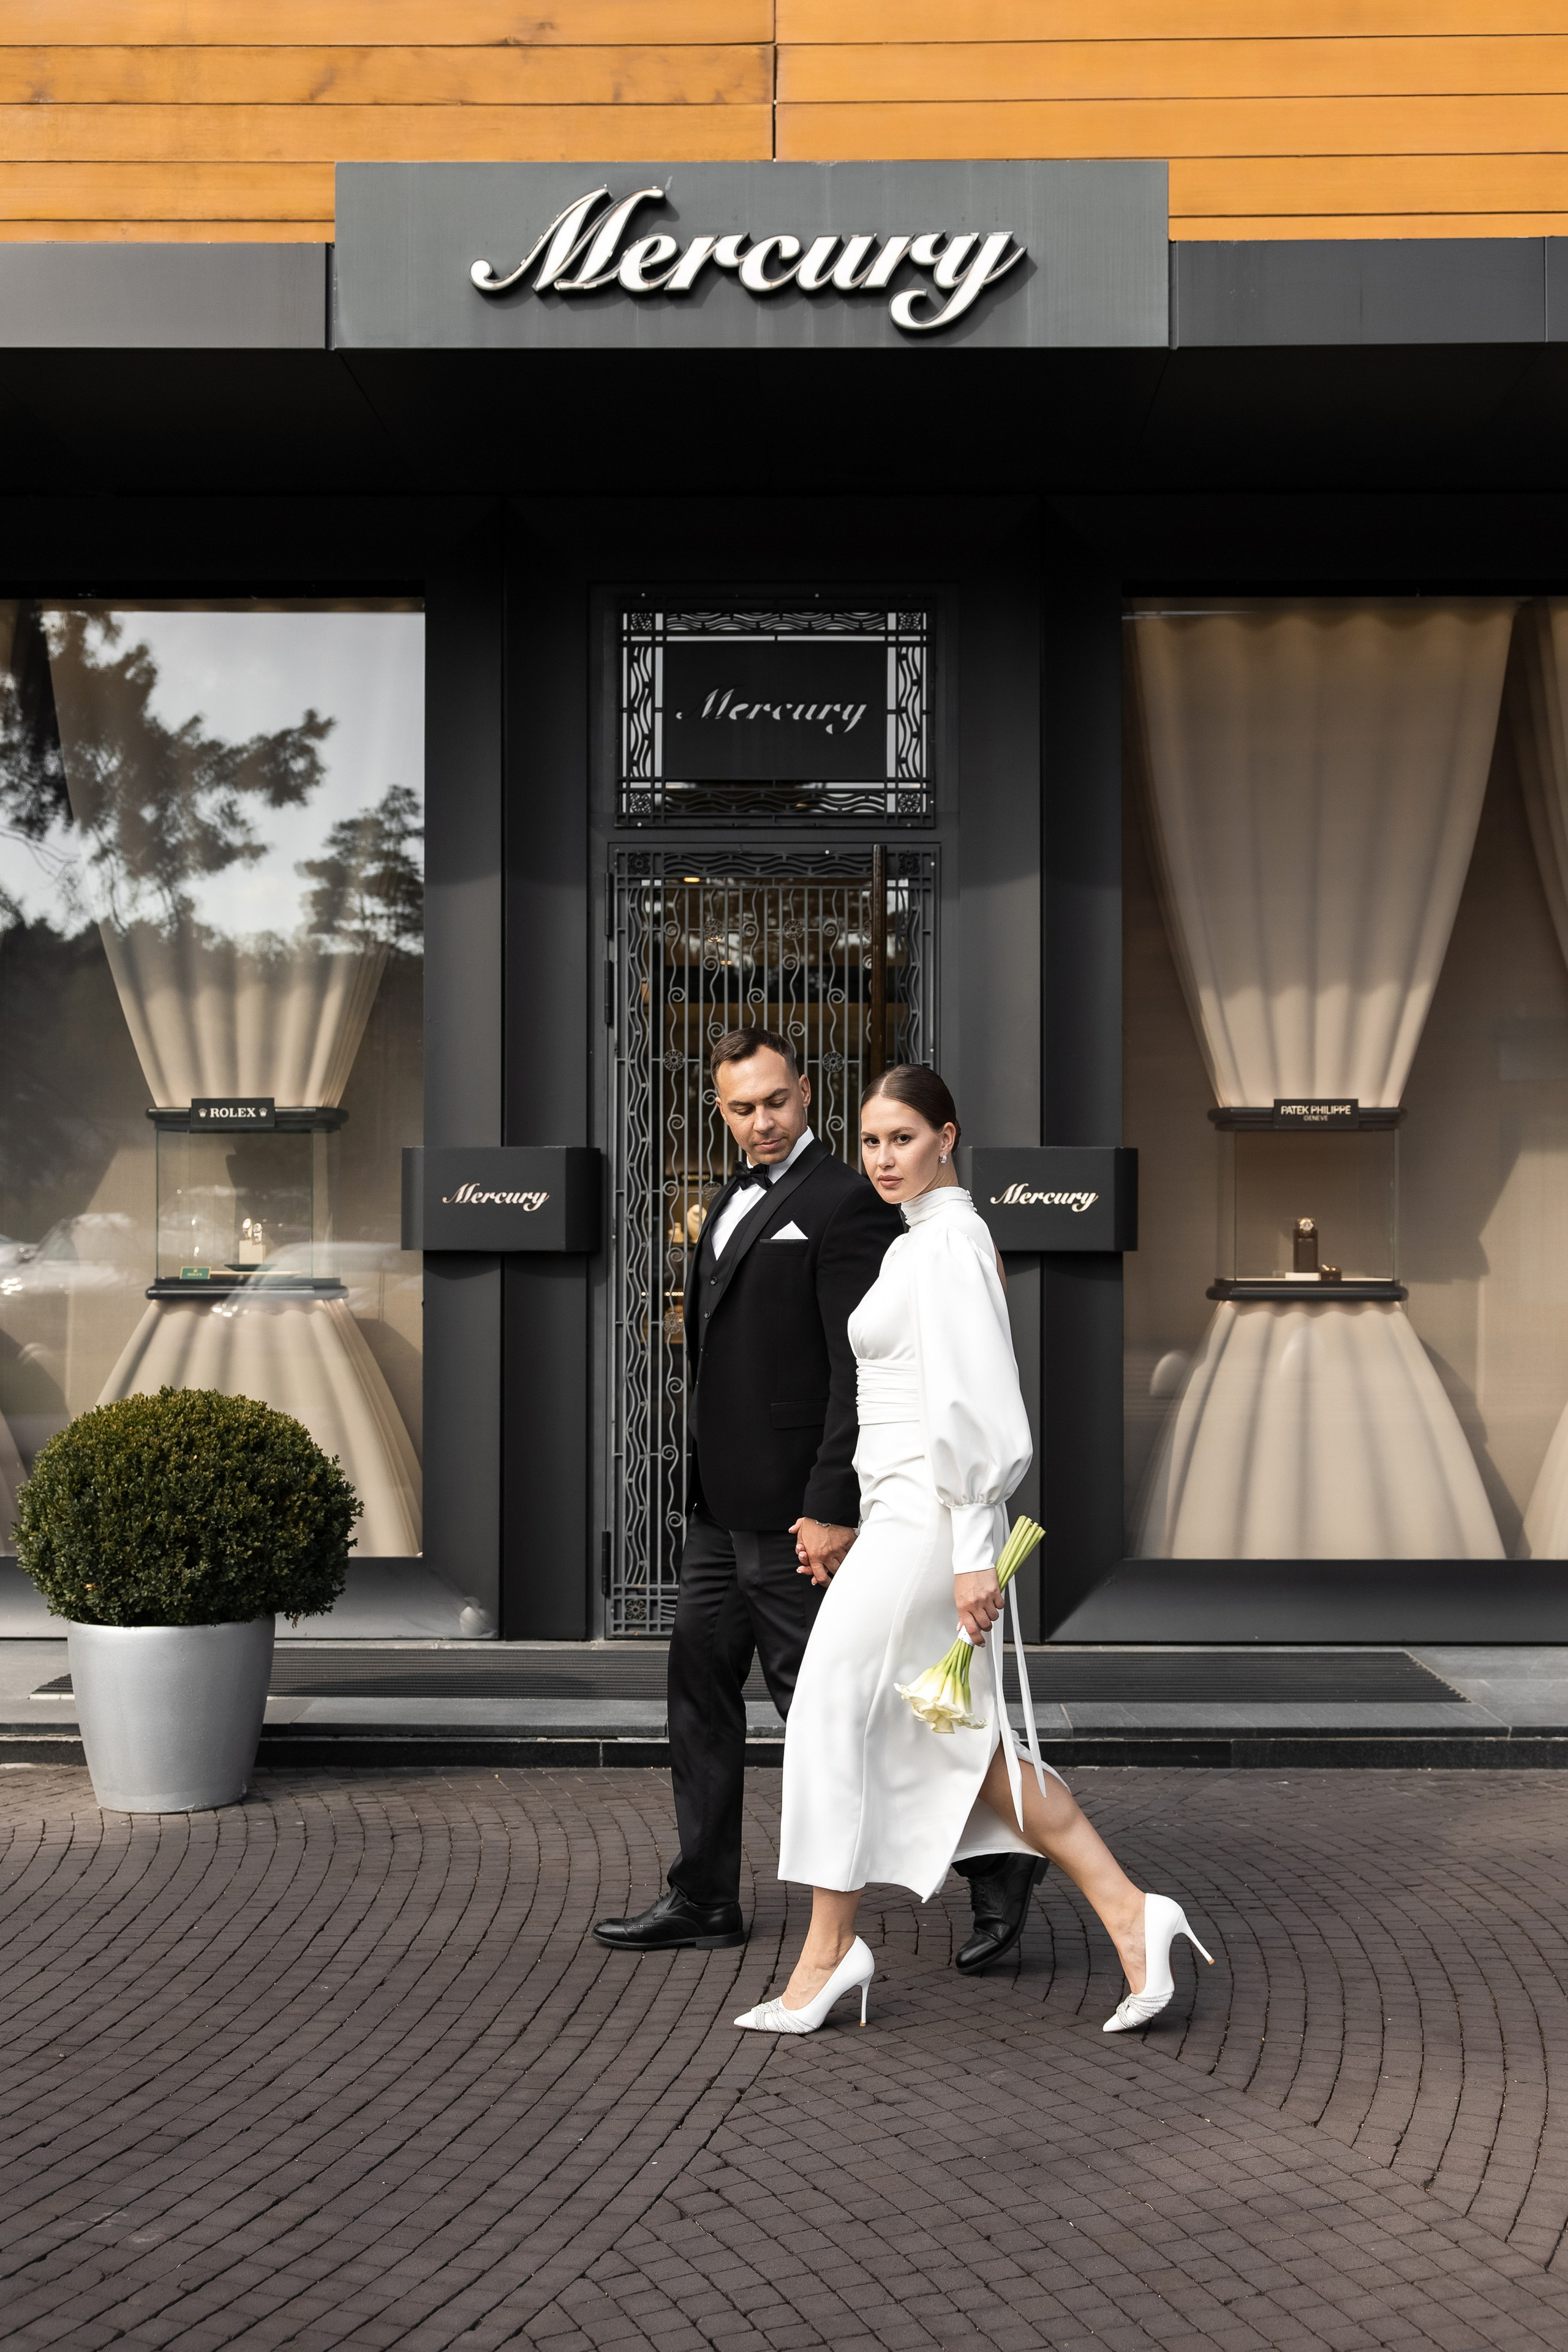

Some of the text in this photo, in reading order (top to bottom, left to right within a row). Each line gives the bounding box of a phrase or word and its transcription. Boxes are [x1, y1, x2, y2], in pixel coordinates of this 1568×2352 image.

[470, 184, 1025, 330] Mercury
[676, 687, 867, 734] Mercury
[209, 1107, 257, 1118] ROLEX
[1281, 1105, 1351, 1115] PATEK PHILIPPE
[442, 1183, 550, 1212] Mercury
[990, 1183, 1099, 1213] Mercury
